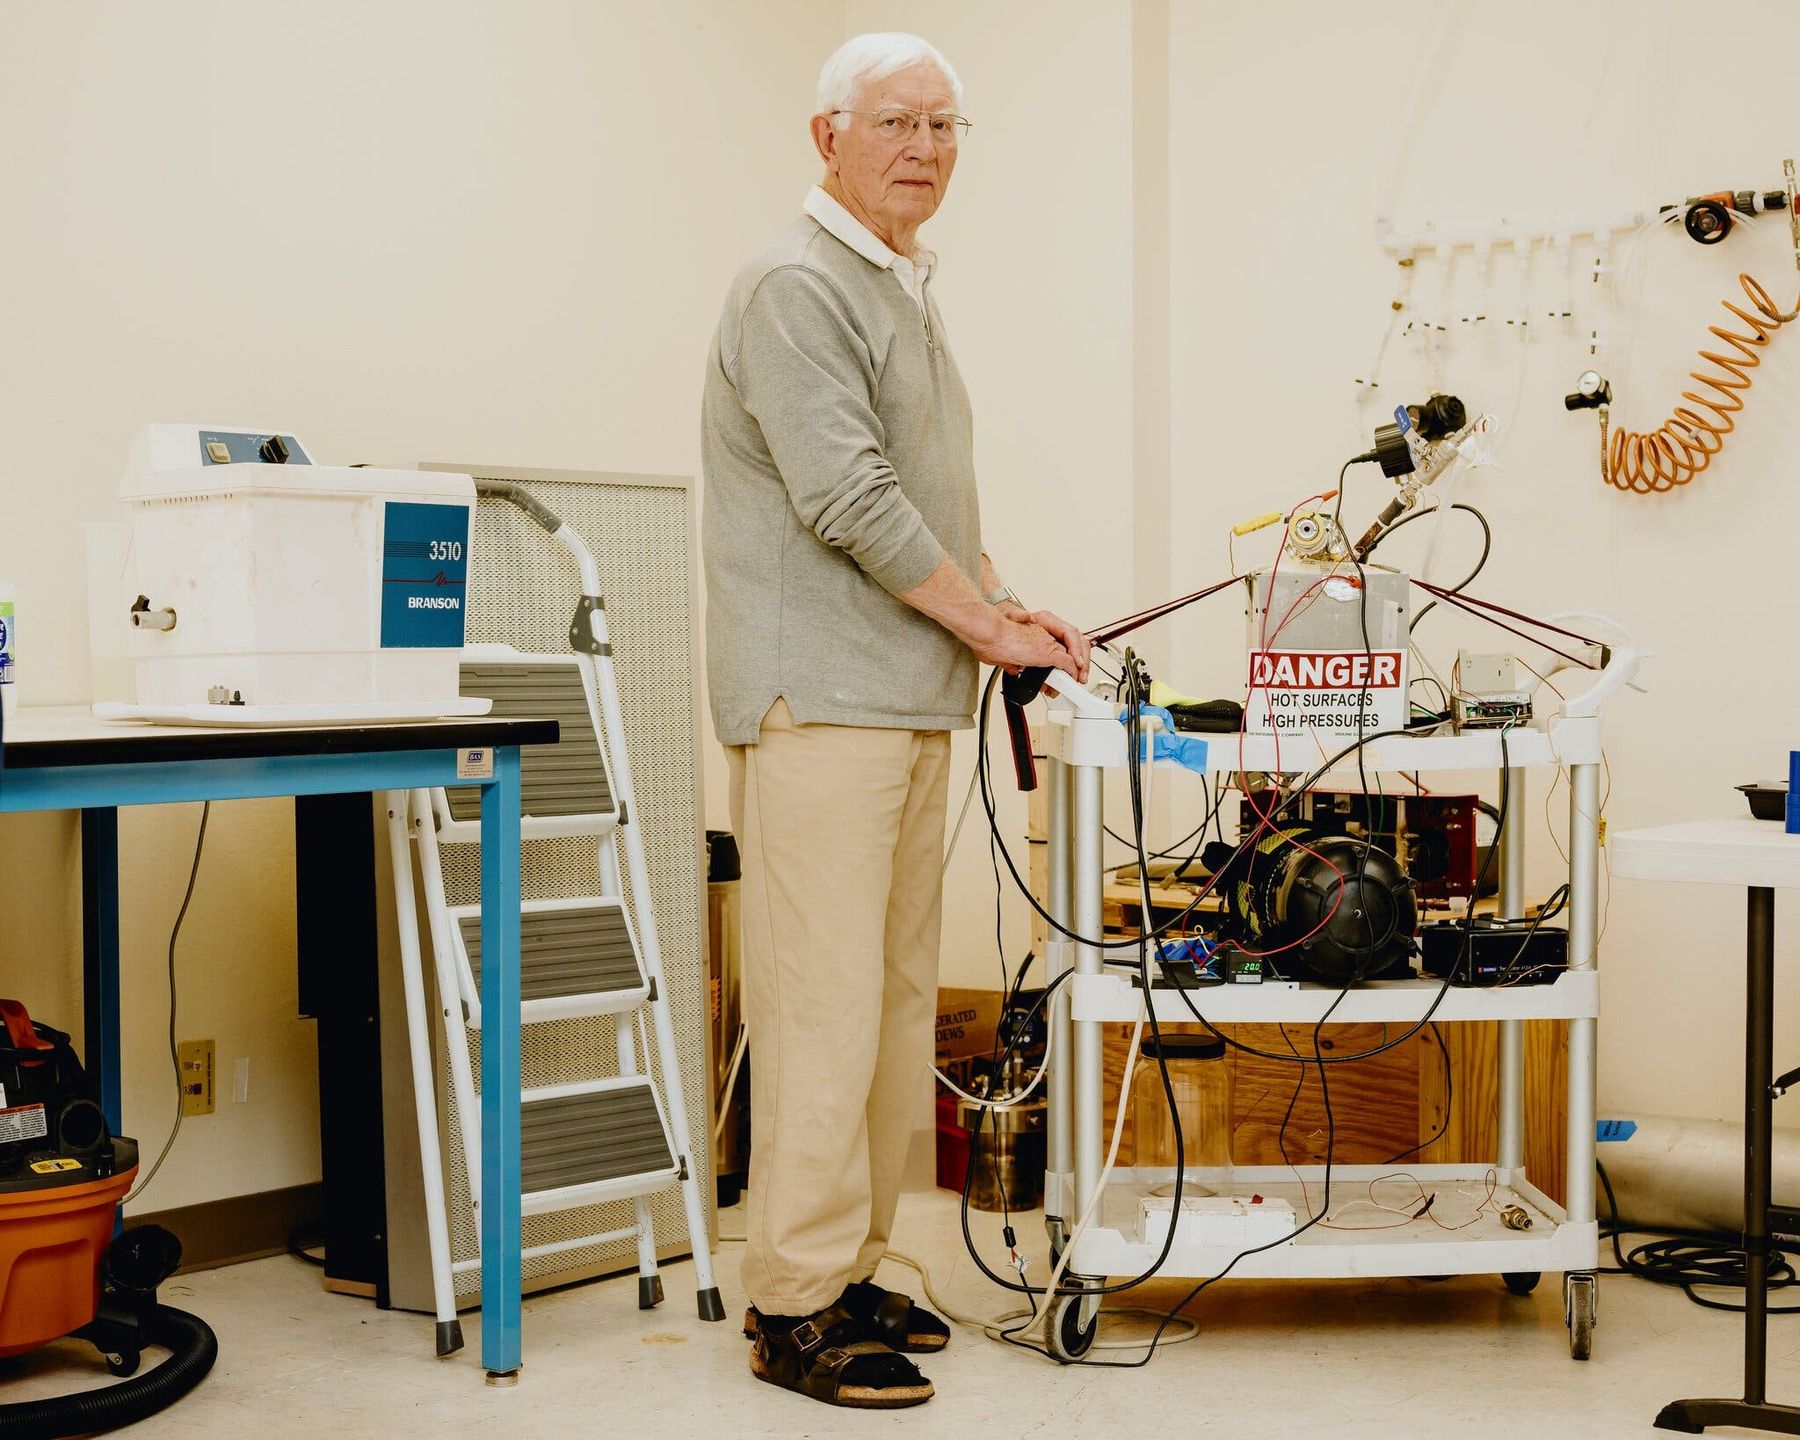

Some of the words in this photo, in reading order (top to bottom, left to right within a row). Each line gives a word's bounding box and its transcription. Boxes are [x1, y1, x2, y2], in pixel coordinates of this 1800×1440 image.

[429, 541, 462, 561] 3510
[408, 597, 460, 610] BRANSON
[1253, 655, 1397, 687] DANGER
[1270, 693, 1299, 707] HOT
[1303, 693, 1373, 707] SURFACES
[1262, 714, 1296, 728] HIGH
[1300, 713, 1379, 728] PRESSURES
[1244, 962, 1260, 971] 20.0
